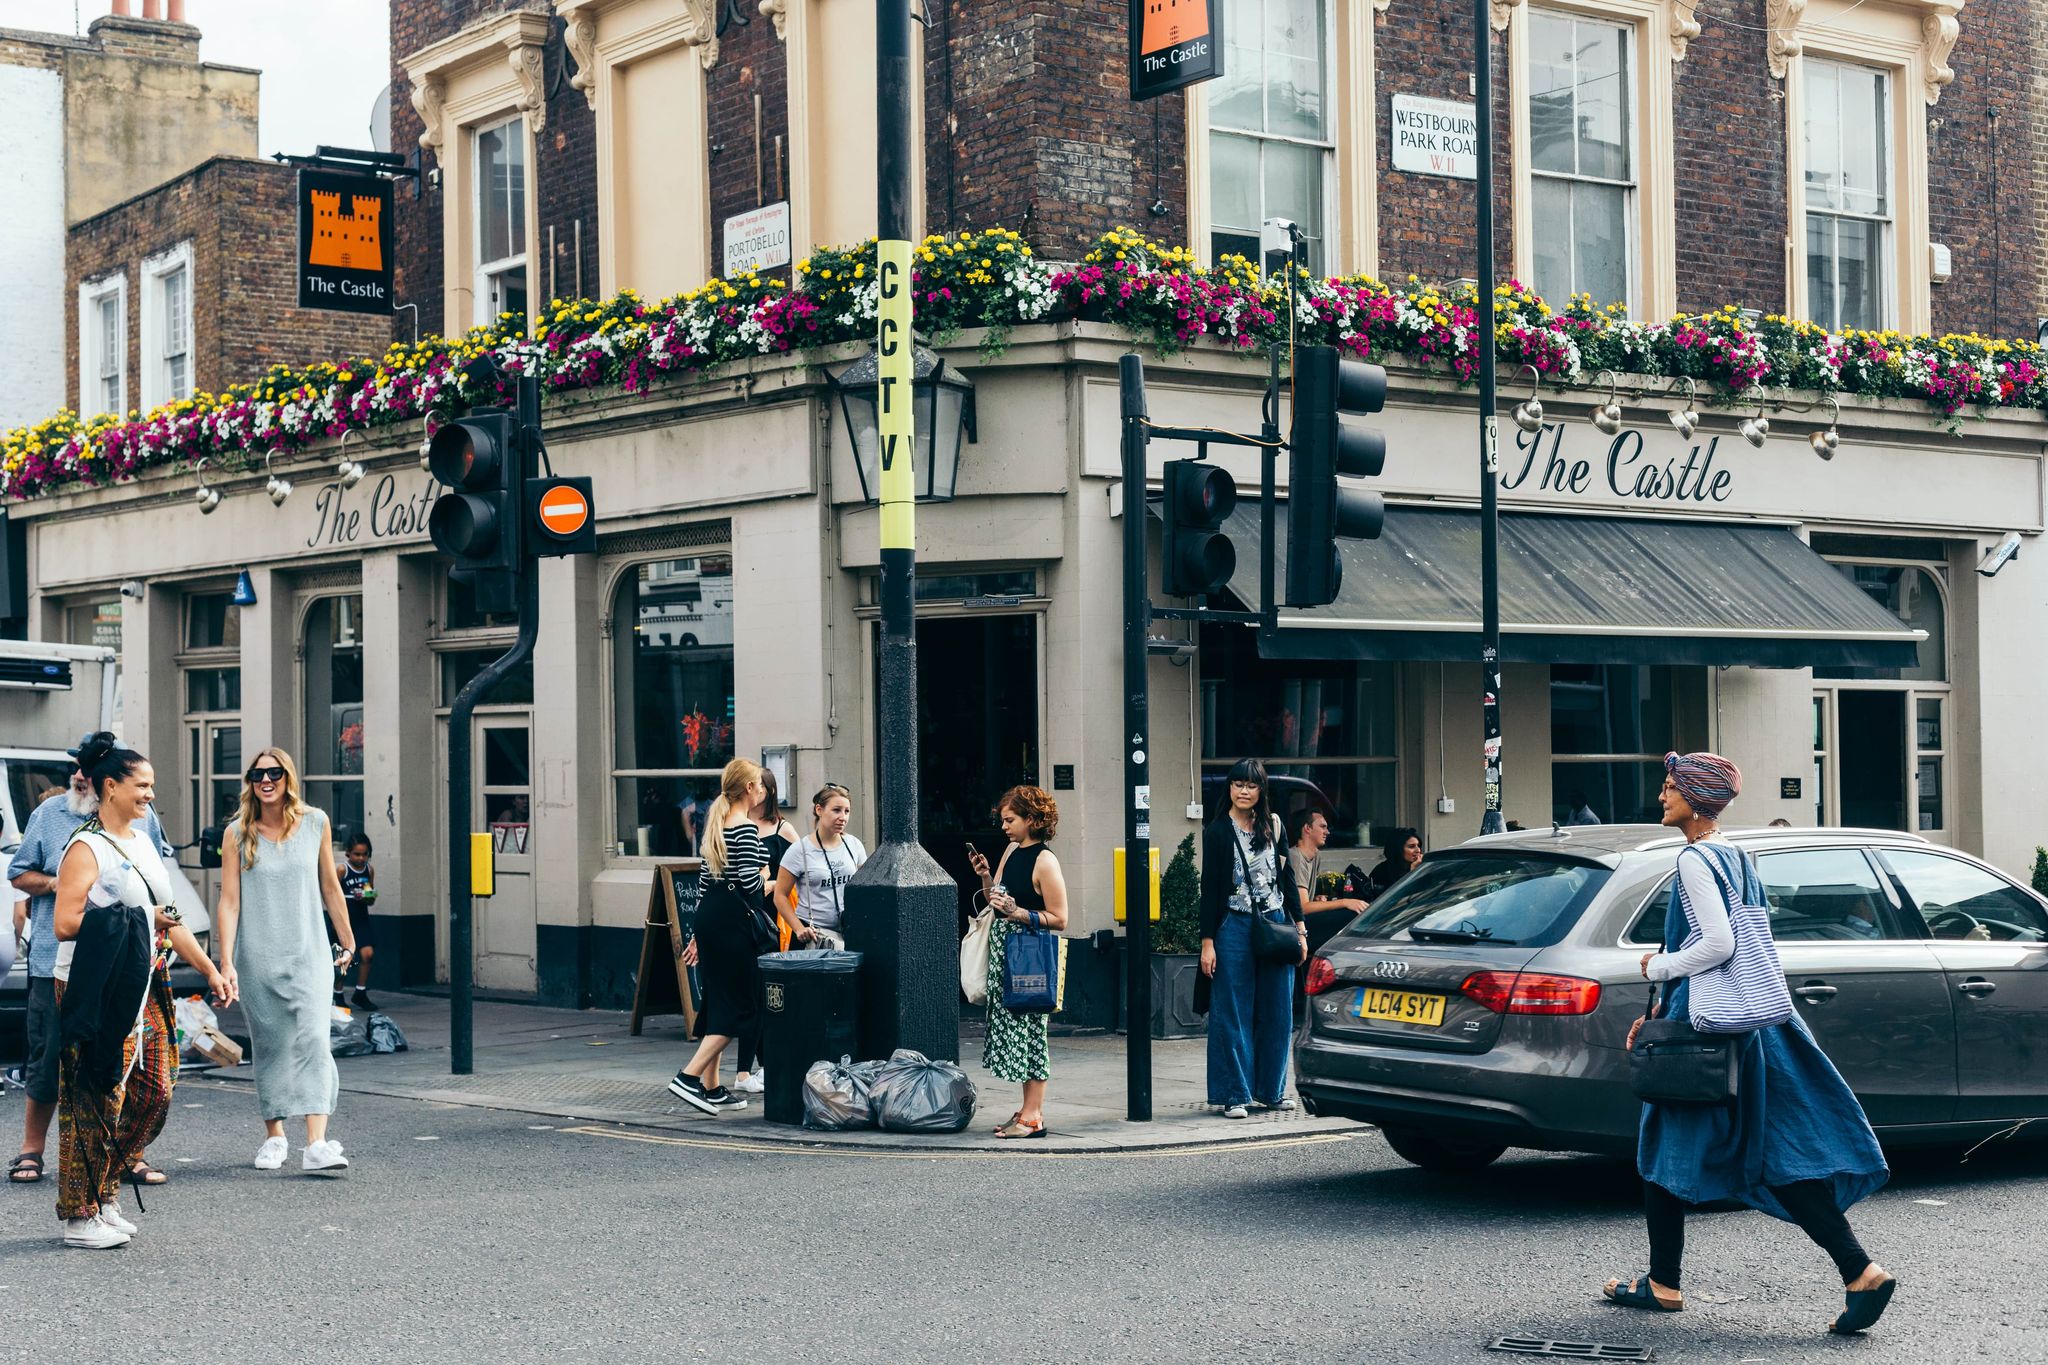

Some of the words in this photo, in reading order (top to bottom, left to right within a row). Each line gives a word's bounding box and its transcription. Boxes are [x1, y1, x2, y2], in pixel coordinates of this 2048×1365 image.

[1143, 56, 1166, 73] The
[1170, 42, 1208, 64] Castle
[1396, 109, 1477, 136] WESTBOURN
[1400, 130, 1437, 151] PARK
[728, 230, 785, 259] PORTOBELLO
[307, 276, 336, 294] The
[340, 279, 385, 299] Castle
[880, 260, 899, 472] CCTV
[1500, 422, 1592, 495] The
[1606, 430, 1733, 502] Castle
[307, 482, 360, 548] The
[370, 474, 443, 538] Cast
[1367, 991, 1402, 1016] LC14
[1406, 996, 1439, 1020] SYT
